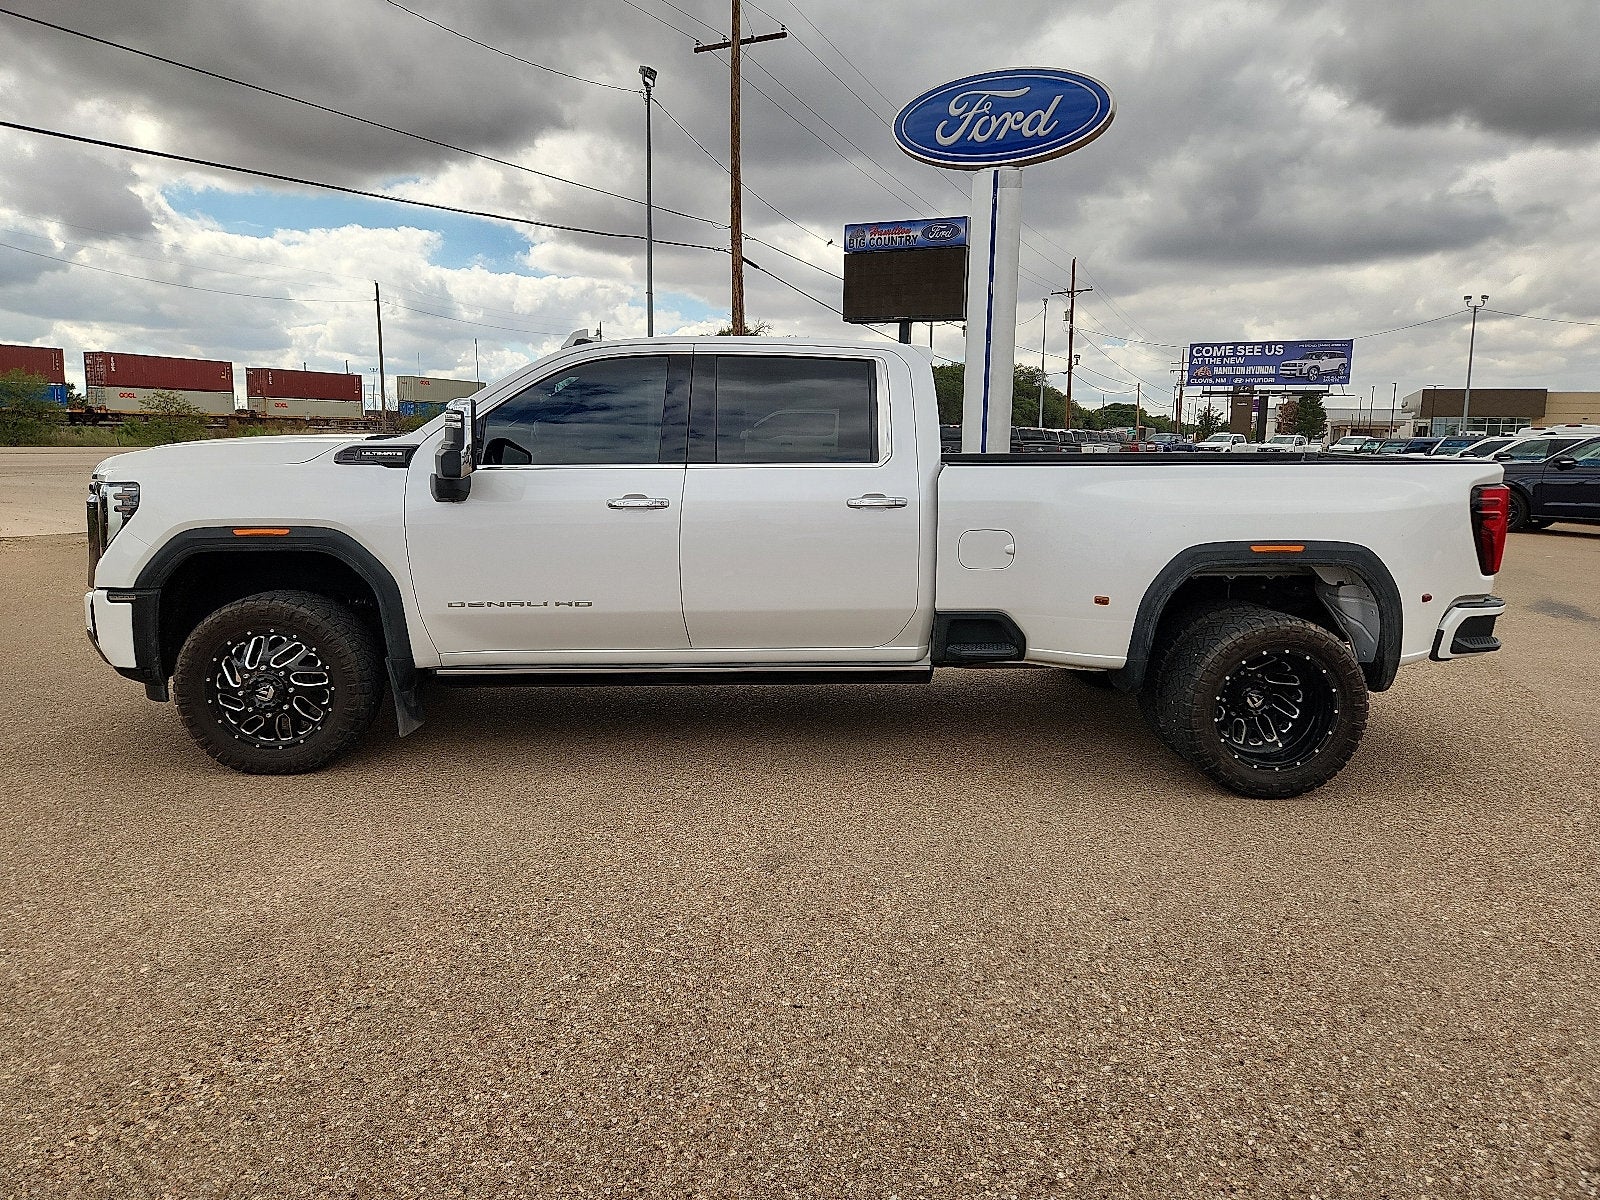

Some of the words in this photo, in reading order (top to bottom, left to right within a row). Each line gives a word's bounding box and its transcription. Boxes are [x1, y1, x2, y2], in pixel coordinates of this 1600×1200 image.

[936, 87, 1063, 146] Ford
[928, 225, 953, 238] Ford
[848, 238, 866, 249] BIG
[868, 234, 918, 247] COUNTRY
[1192, 345, 1234, 357] COME
[1236, 345, 1262, 356] SEE
[1265, 344, 1284, 356] US
[1192, 357, 1203, 365] AT
[1203, 357, 1222, 365] THE
[1213, 366, 1246, 375] HAMILTON
[1246, 365, 1276, 374] HYUNDAI
